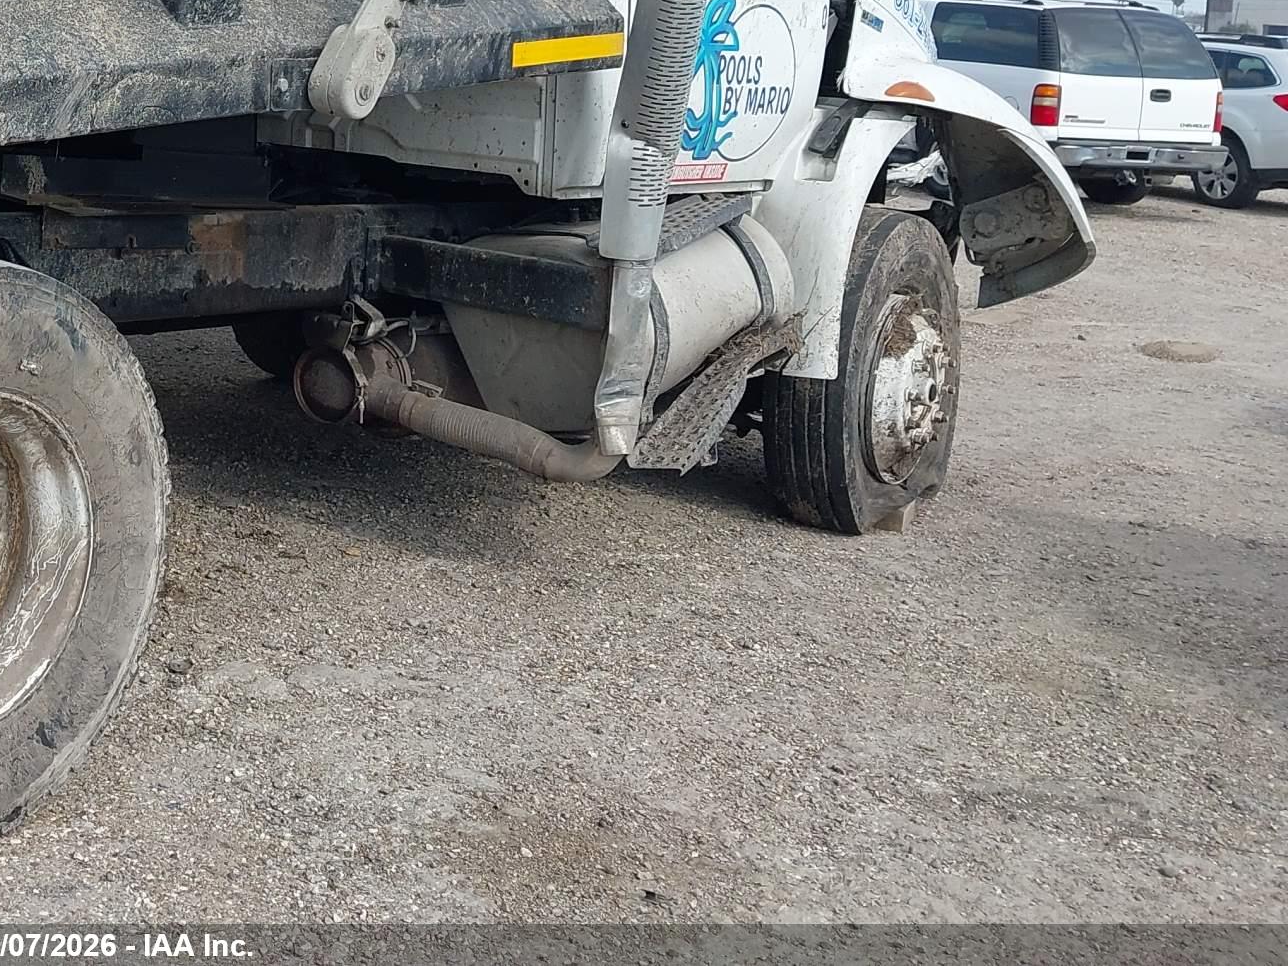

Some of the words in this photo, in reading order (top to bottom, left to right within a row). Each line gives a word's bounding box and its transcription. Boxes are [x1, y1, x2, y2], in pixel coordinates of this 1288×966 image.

[717, 54, 763, 85] POOLS
[722, 86, 744, 115] BY
[744, 86, 791, 115] MARIO
